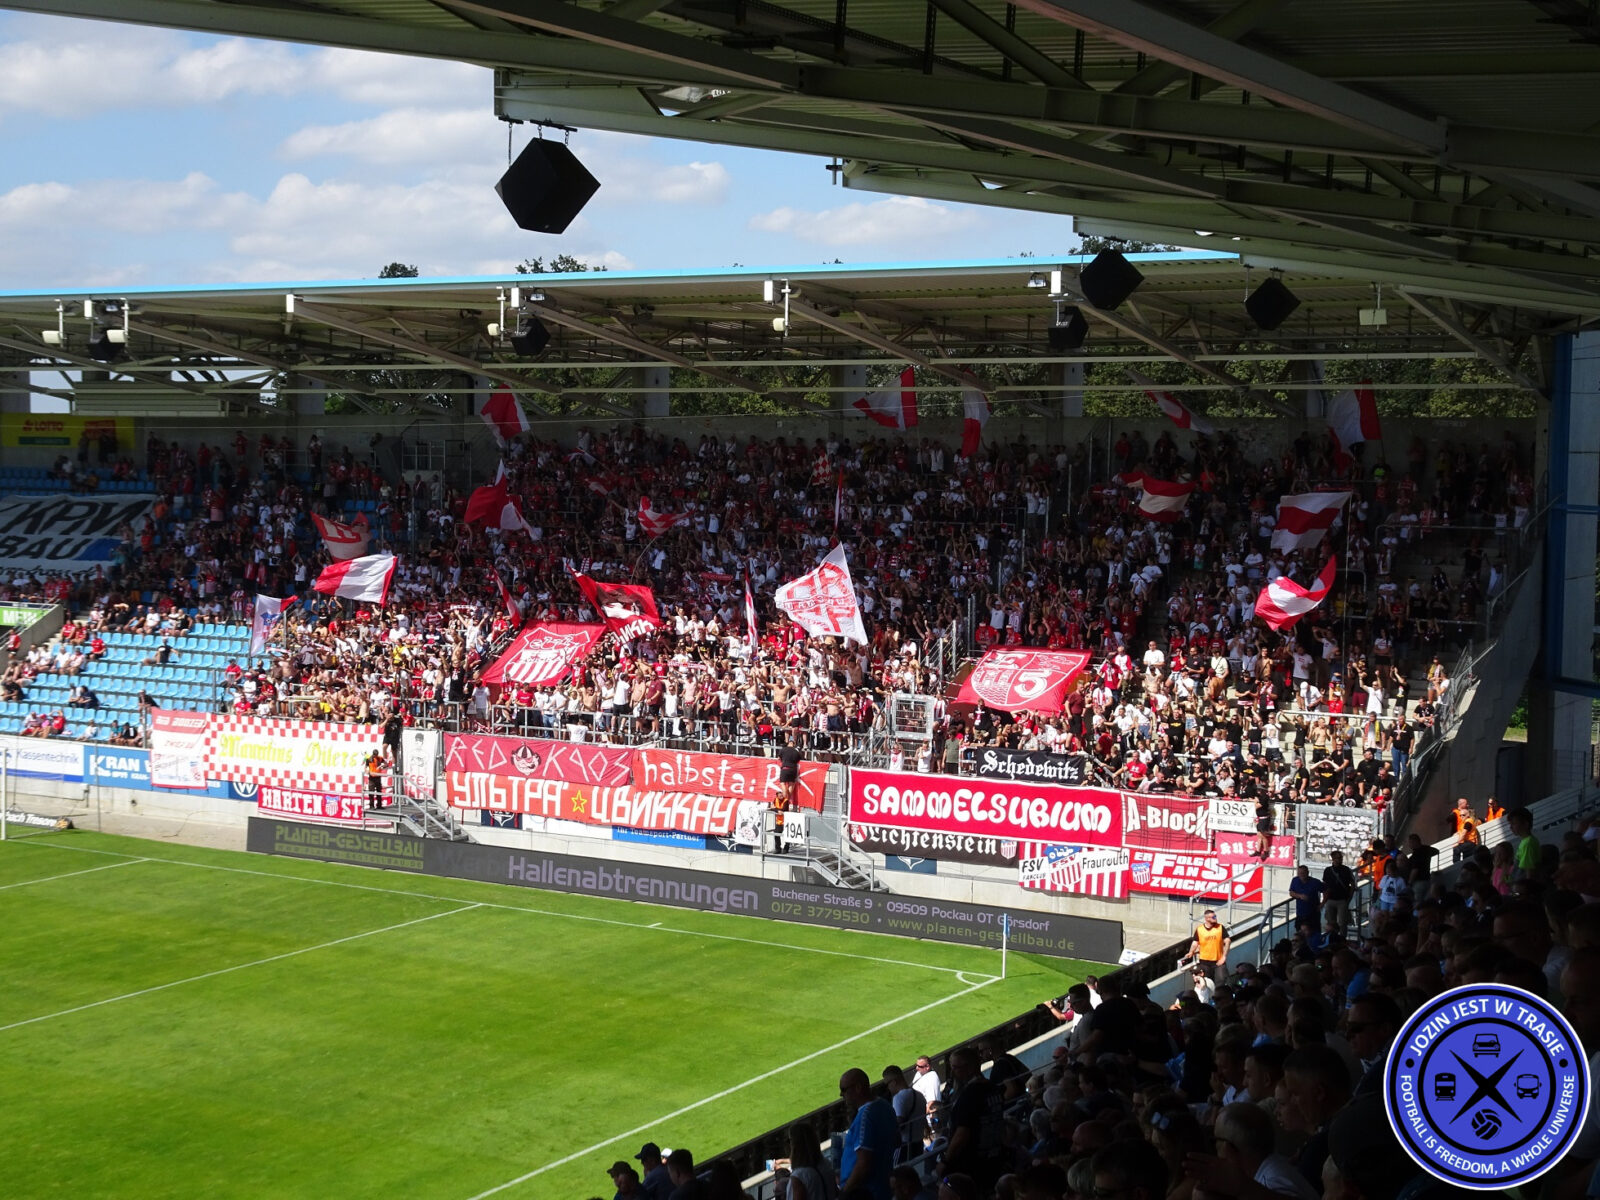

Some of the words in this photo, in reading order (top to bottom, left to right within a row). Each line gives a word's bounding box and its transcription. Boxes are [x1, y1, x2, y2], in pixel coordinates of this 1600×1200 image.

[89, 754, 140, 776] KRAN
[445, 736, 508, 770] RED
[980, 750, 1080, 781] Schedewitz
[863, 783, 1112, 834] SAMMELSUBIUM
[1216, 802, 1248, 816] 1986
[784, 822, 804, 839] 19A
[1021, 858, 1044, 873] FSV
[508, 855, 759, 912] Hallenabtrennungen
[771, 887, 820, 903] Buchener
[823, 892, 861, 909] Straße
[863, 897, 873, 909] 9
[886, 901, 928, 916] 09509
[931, 907, 973, 923] Pockau
[977, 912, 994, 924] OT
[771, 901, 802, 916] 0172
[807, 905, 870, 925] 3779530
[887, 917, 1075, 951] www.planen-gesellbau.de
